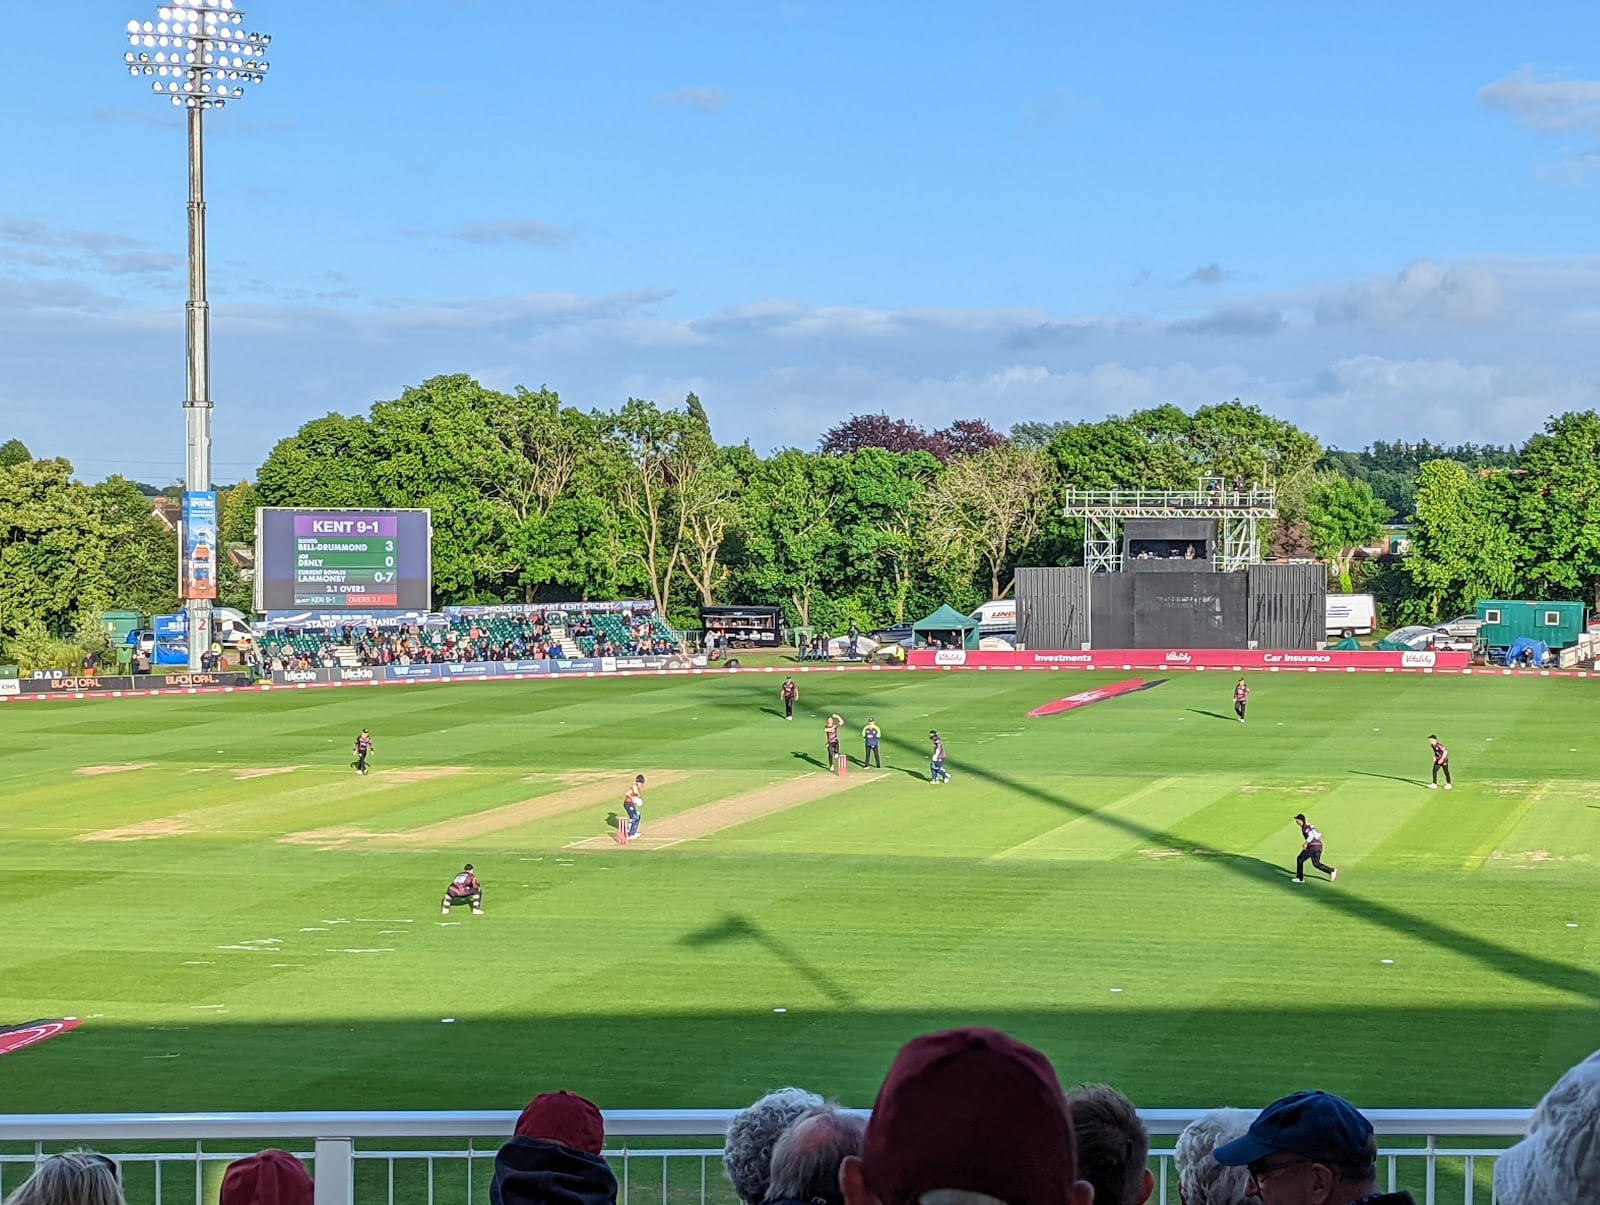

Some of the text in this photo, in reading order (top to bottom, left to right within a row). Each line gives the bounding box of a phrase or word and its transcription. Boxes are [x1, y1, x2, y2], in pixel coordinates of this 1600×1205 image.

[313, 520, 379, 533] KENT 9-1
[298, 540, 394, 552] BELL-DRUMMOND 3
[298, 556, 394, 567] DENLY 0
[298, 572, 394, 583] LAMMONBY 0-7
[326, 585, 366, 593] 2.1 OVERS
[524, 604, 558, 612] SUPPORT
[560, 603, 581, 611] KENT
[582, 602, 615, 610] CRICKET
[198, 618, 206, 631] 2
[305, 620, 336, 629] STAND
[366, 619, 396, 627] STAND
[1165, 651, 1191, 664] Vitality
[1264, 653, 1281, 662] Car
[1406, 653, 1432, 665] Vitality
[34, 671, 63, 680] BAR
[192, 675, 215, 684] OPAL
[78, 678, 102, 687] OPAL
